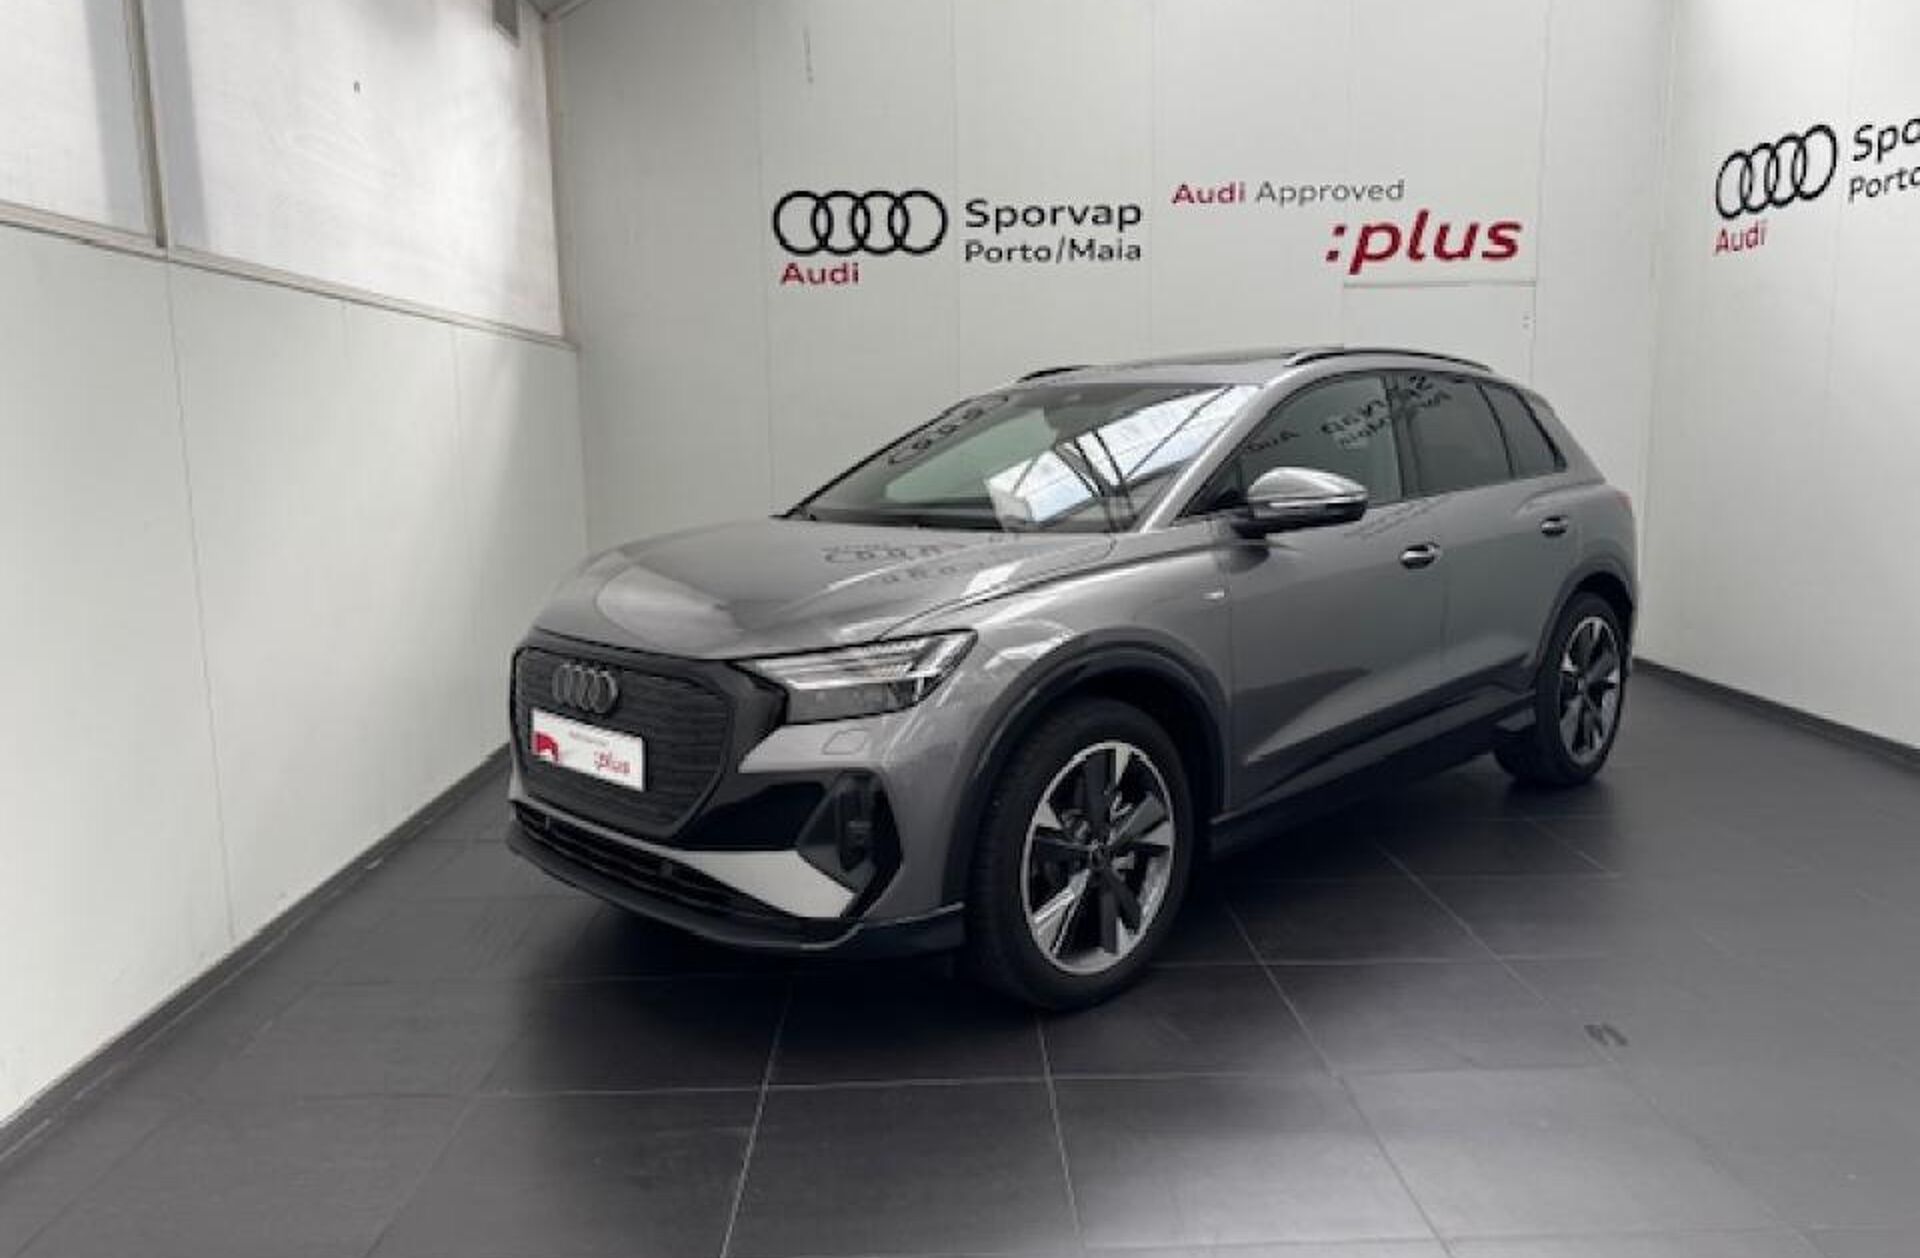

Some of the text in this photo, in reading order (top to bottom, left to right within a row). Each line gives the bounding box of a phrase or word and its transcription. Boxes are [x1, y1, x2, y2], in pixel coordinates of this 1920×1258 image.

[1171, 179, 1405, 208] Audi Approved
[964, 198, 1143, 234] Sporvap
[964, 236, 1142, 264] Porto/Maia
[1325, 208, 1523, 275] :plus
[1714, 219, 1767, 256] Audi
[780, 262, 860, 285] Audi
